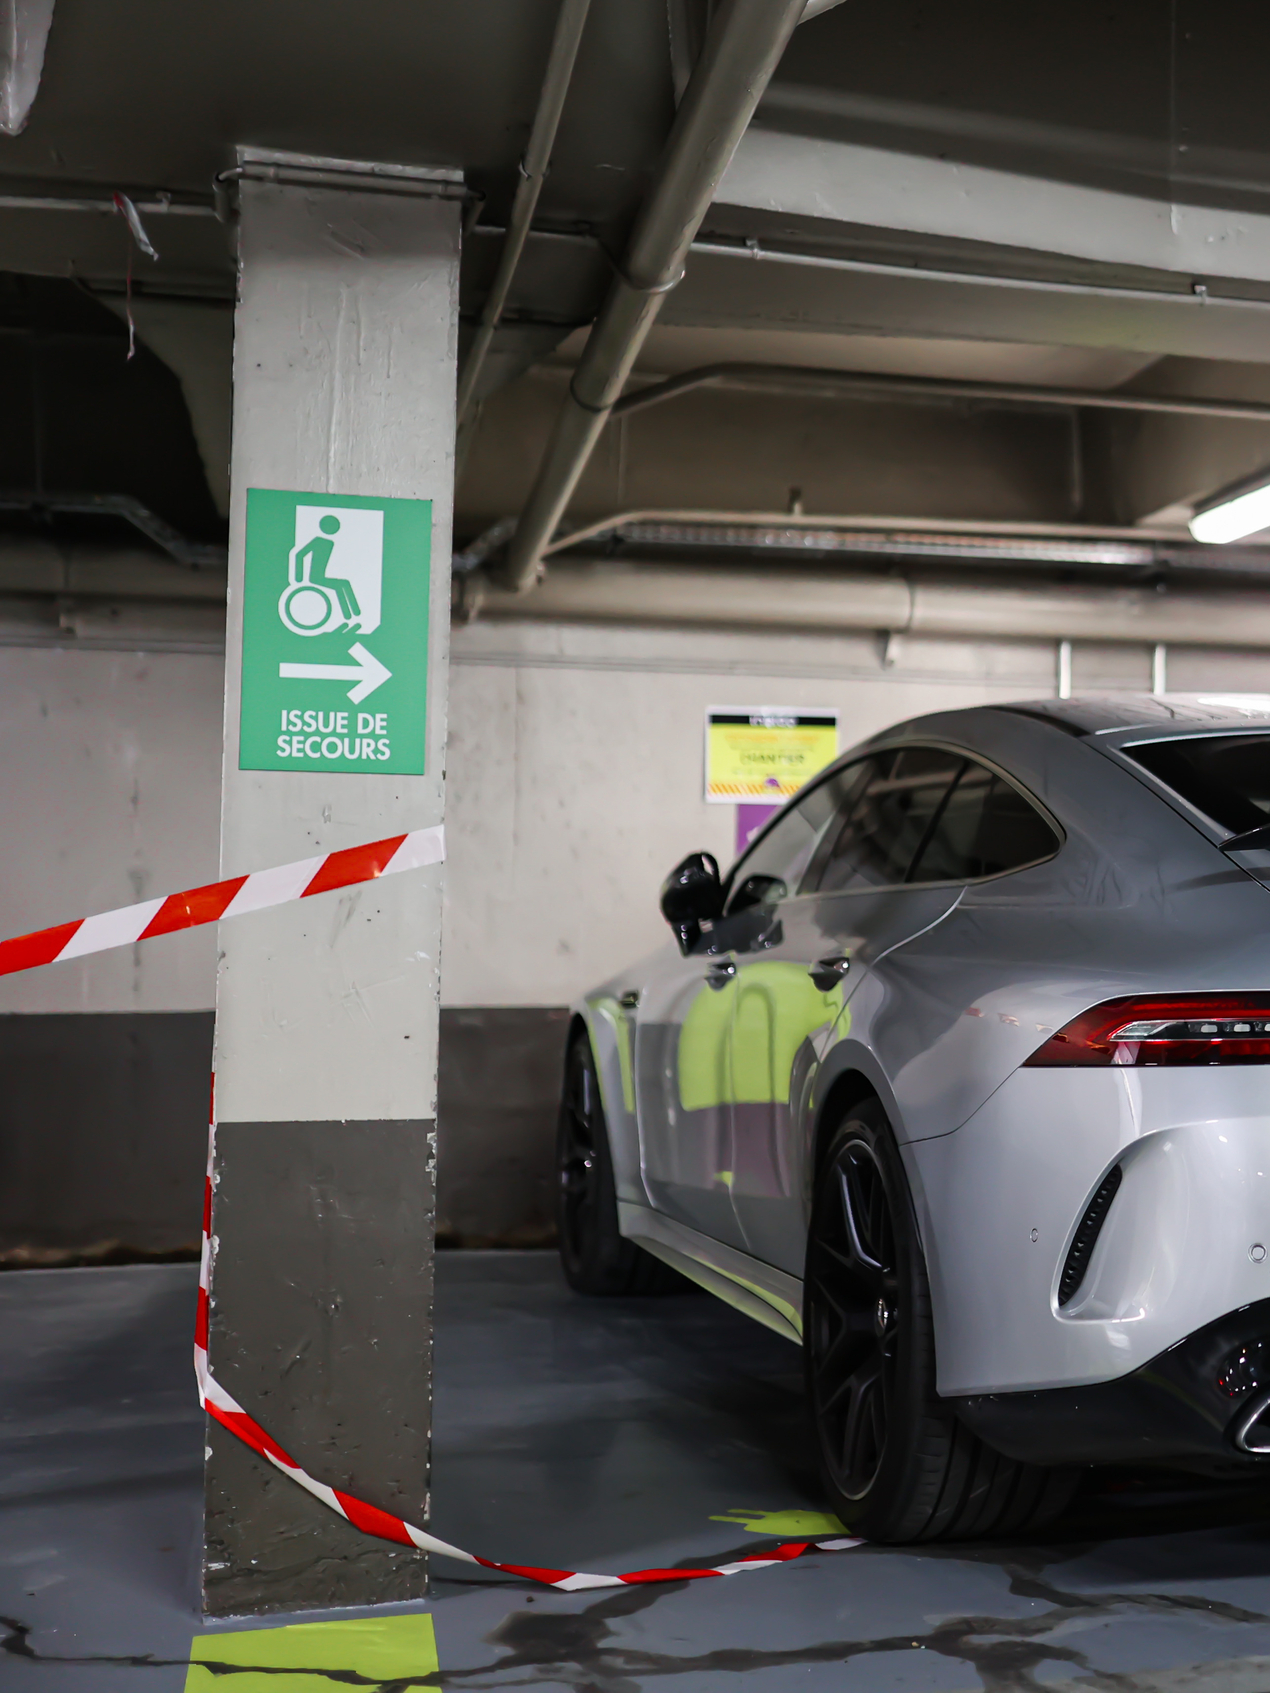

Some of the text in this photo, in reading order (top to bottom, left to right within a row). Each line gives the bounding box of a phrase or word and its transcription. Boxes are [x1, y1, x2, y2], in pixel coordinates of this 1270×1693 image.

[281, 709, 388, 735] ISSUE DE
[276, 734, 391, 760] SECOURS
